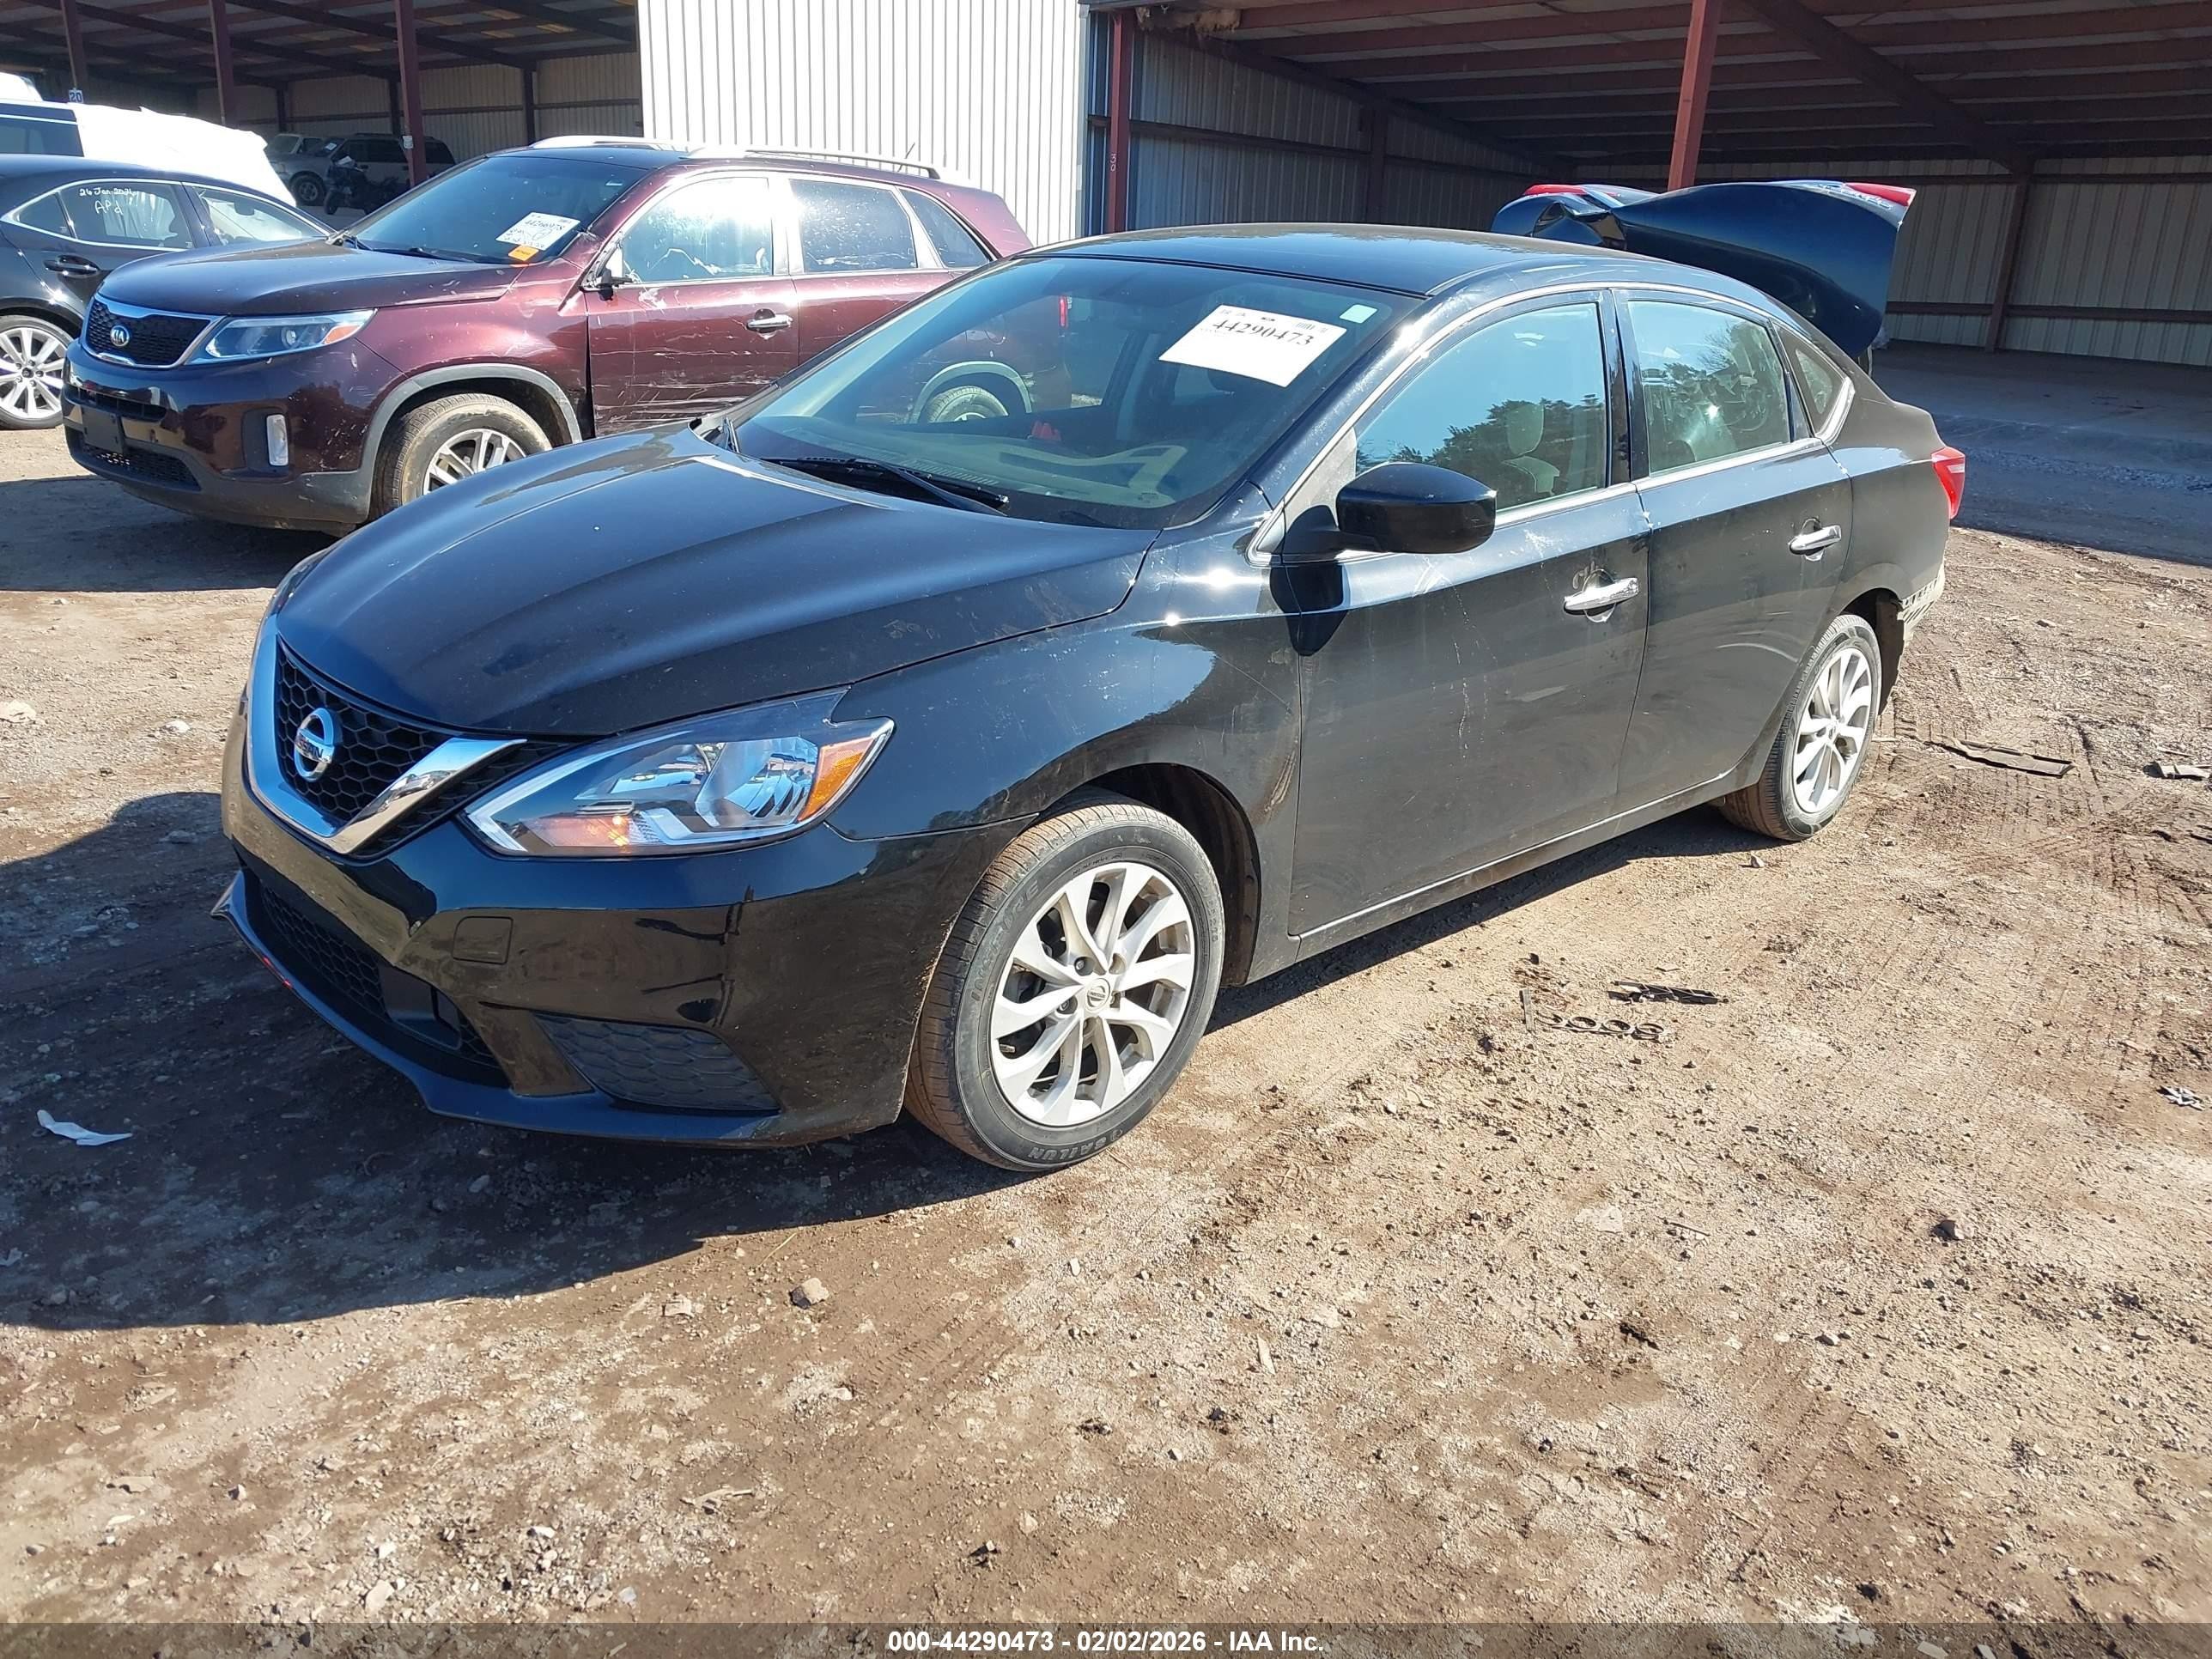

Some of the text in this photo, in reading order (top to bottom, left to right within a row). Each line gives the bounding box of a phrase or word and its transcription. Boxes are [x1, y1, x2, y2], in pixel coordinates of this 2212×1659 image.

[69, 92, 82, 103] 20
[79, 188, 93, 197] 26
[111, 329, 125, 344] KIA
[1212, 319, 1315, 345] 44290473
[1028, 1137, 1107, 1161] SAILUN
